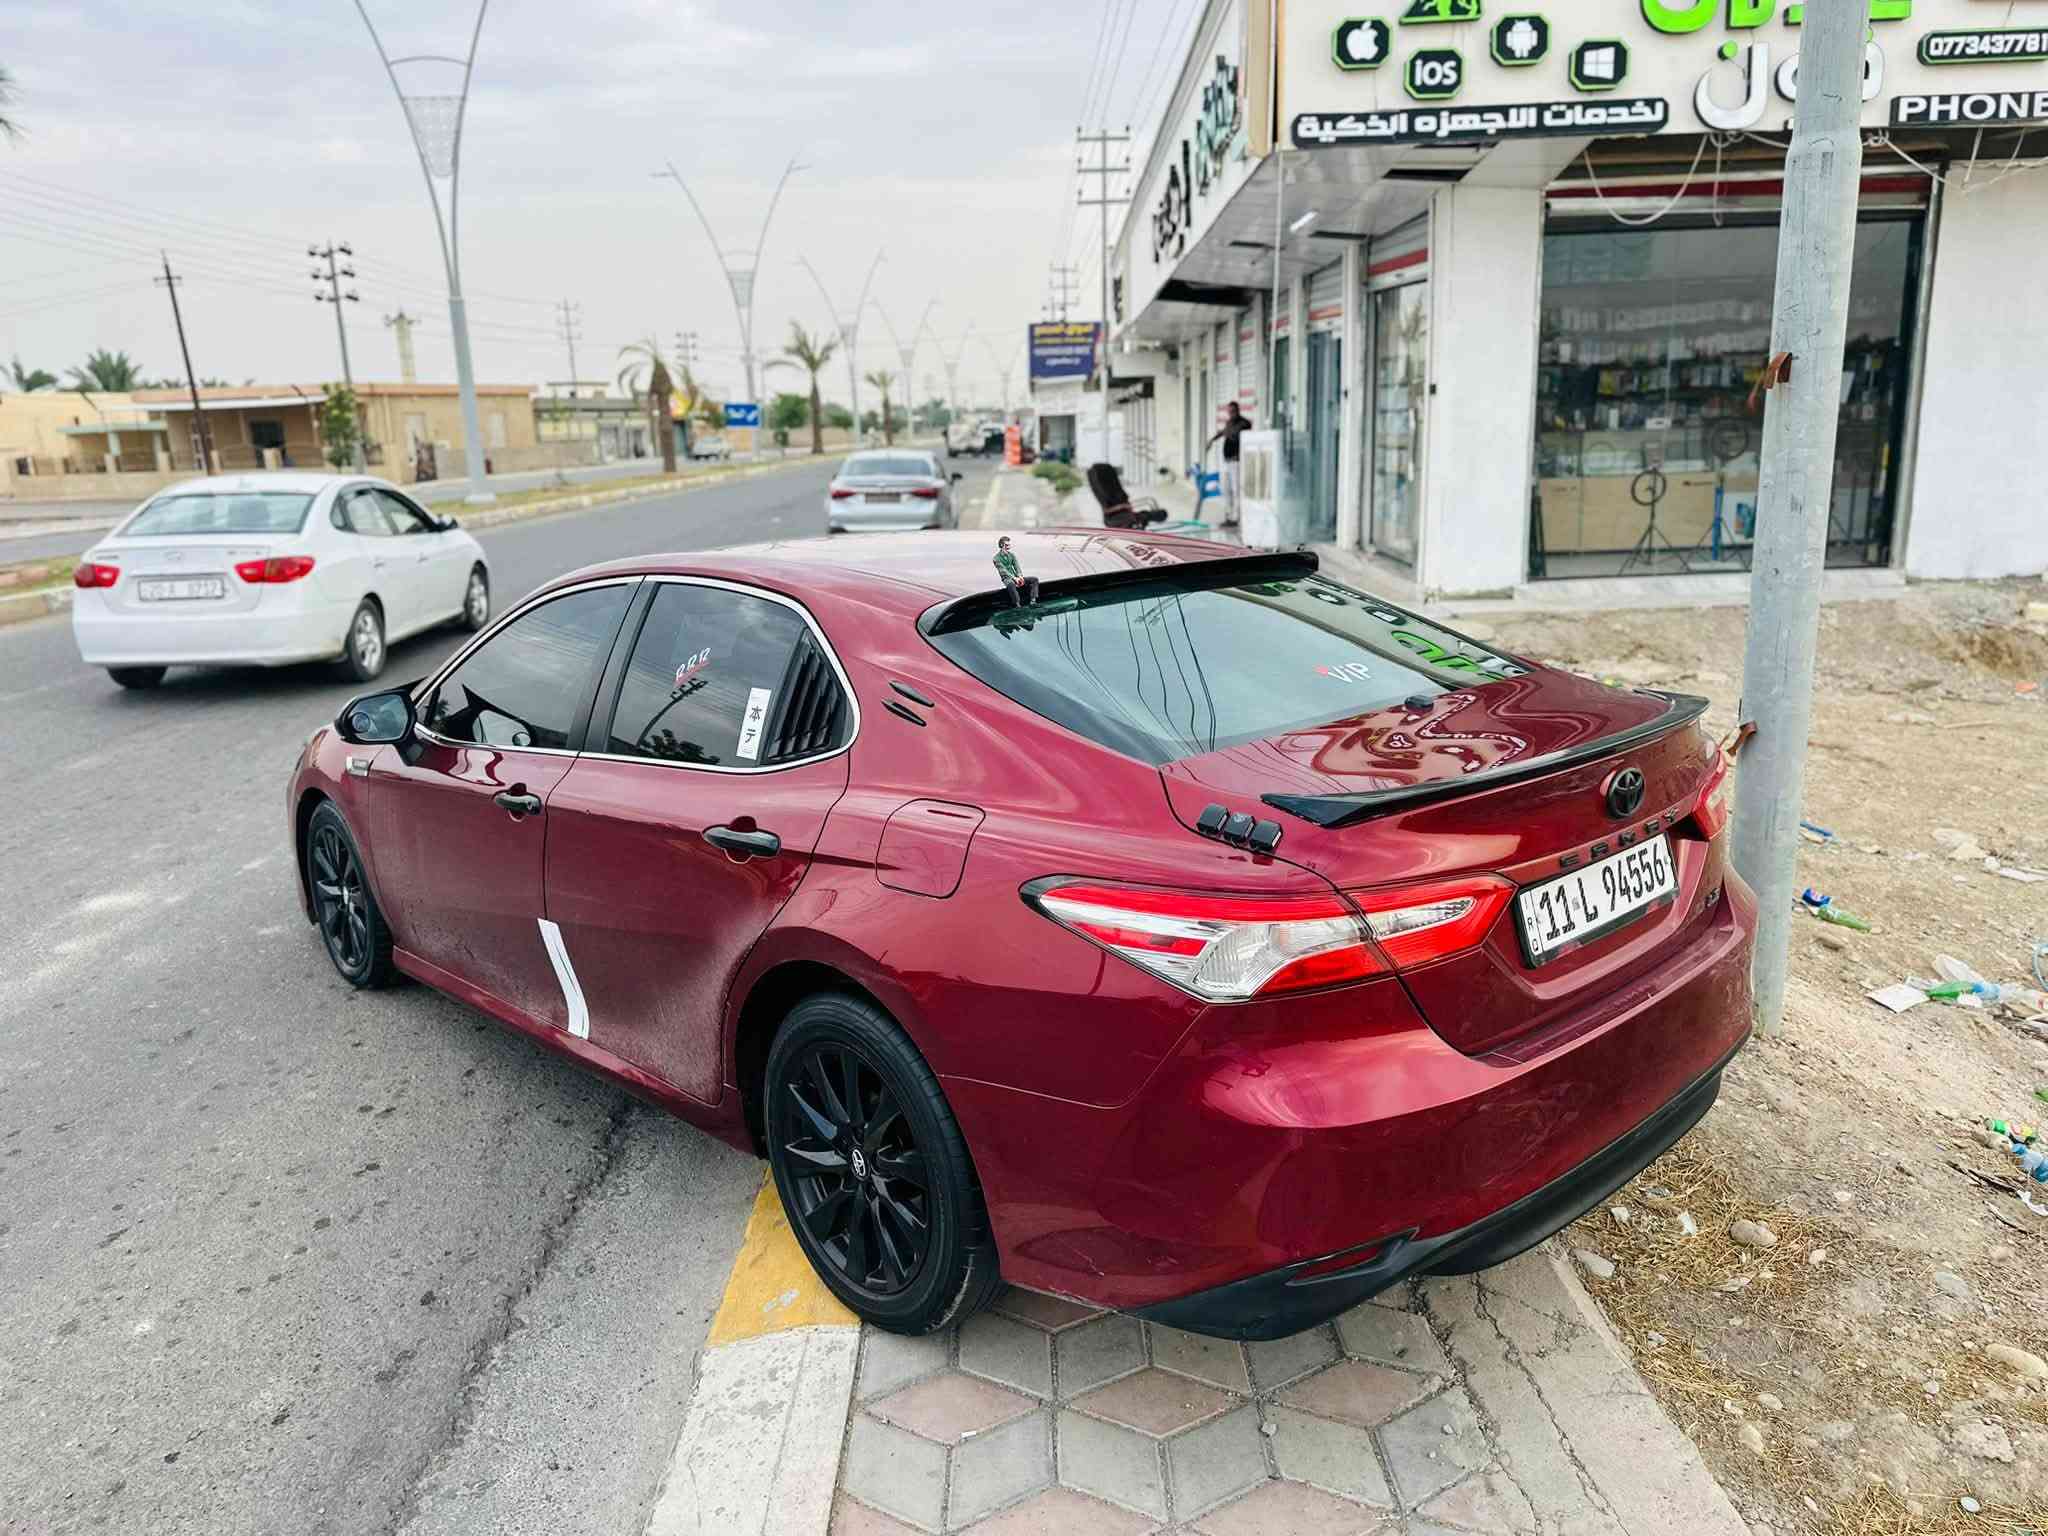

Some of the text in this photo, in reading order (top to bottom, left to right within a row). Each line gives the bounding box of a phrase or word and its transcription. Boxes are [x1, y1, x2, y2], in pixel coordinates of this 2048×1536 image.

[1414, 59, 1458, 87] iOS
[1297, 112, 1409, 143] الذكية
[1543, 101, 1664, 127] لخدمات
[1540, 884, 1576, 941] 11
[1601, 842, 1666, 912] 94556
